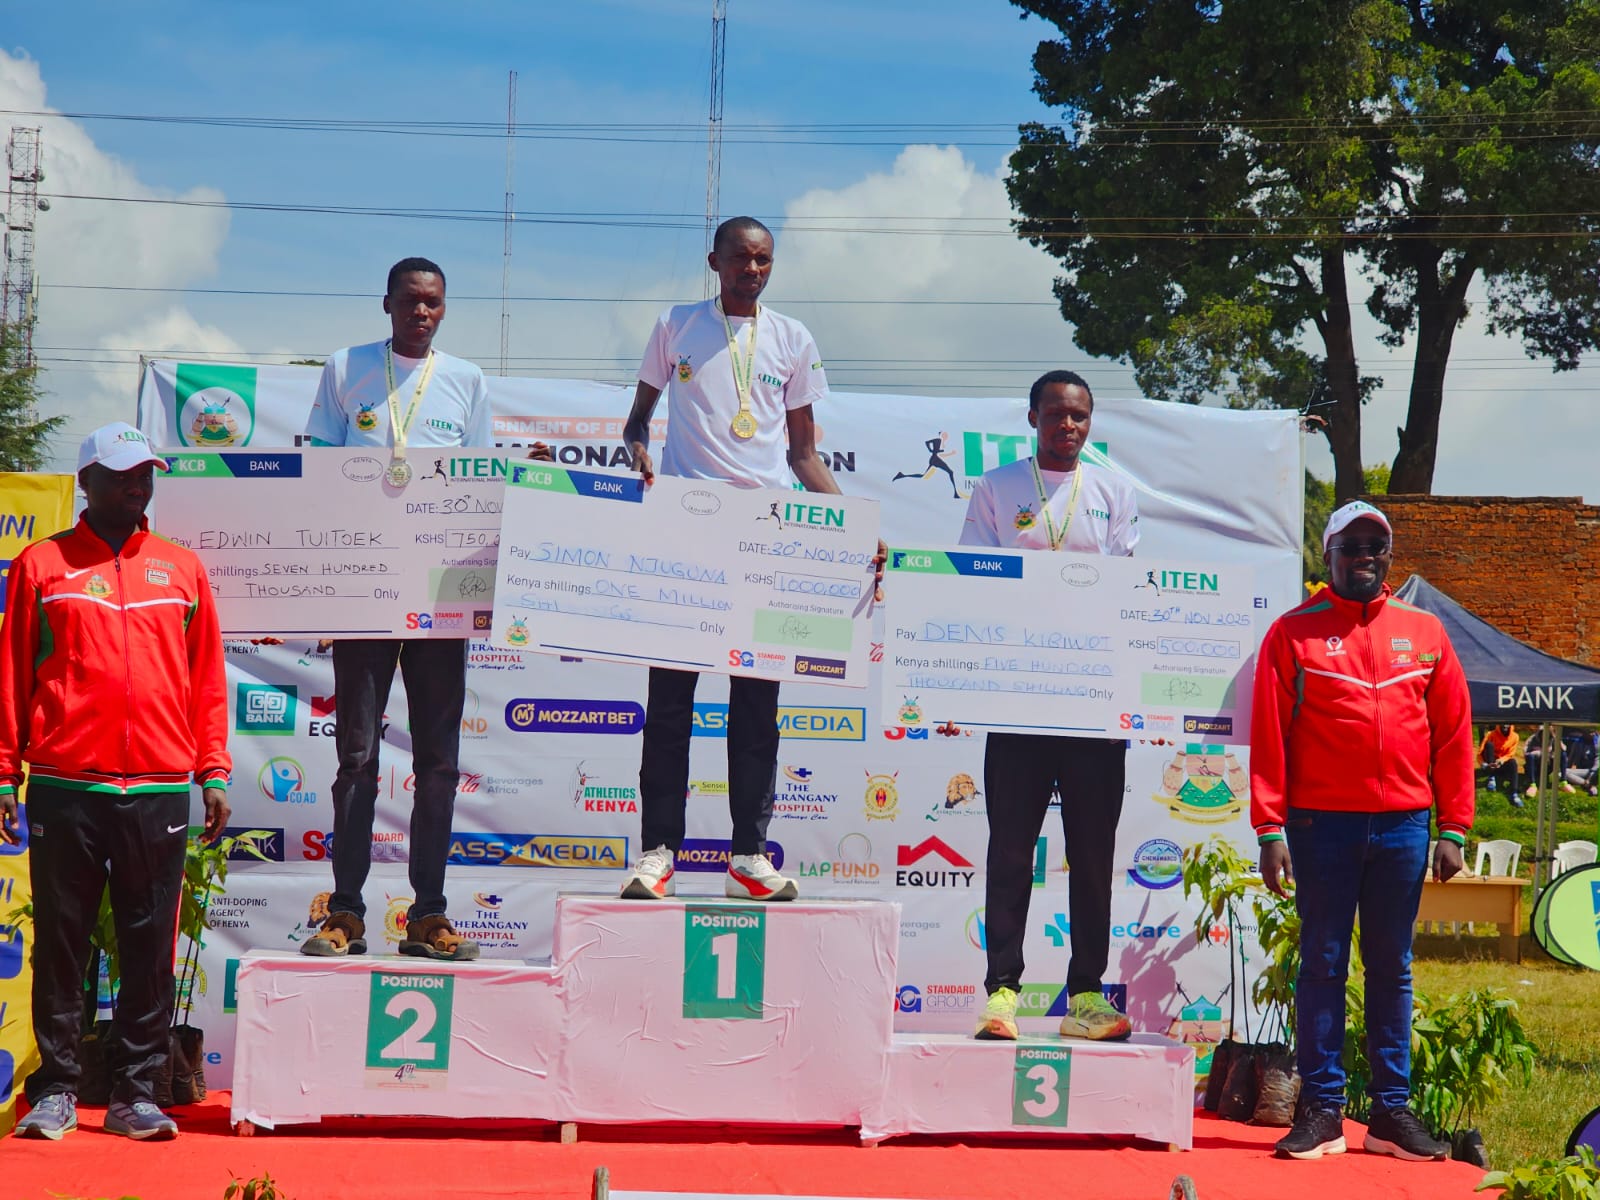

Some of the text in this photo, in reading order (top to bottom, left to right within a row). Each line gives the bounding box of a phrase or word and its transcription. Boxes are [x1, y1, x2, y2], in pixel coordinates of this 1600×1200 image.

[762, 373, 782, 388] ITEN
[431, 419, 453, 430] ITEN
[494, 420, 570, 435] RNMENT
[576, 422, 601, 434] OF
[178, 459, 280, 471] KCB BANK
[450, 457, 508, 477] ITEN
[526, 470, 624, 494] KCB BANK
[406, 503, 438, 514] DATE:
[784, 503, 845, 527] ITEN
[200, 531, 271, 549] EDWIN
[295, 529, 383, 547] TUITOEK
[415, 533, 445, 544] KSHS
[739, 541, 770, 555] DATE:
[441, 558, 484, 567] Authorising
[510, 542, 727, 584] Pay SIMON NJUGUNA
[906, 555, 1003, 571] KCB BANK
[209, 562, 388, 579] shillings SEVEN HUNDRED
[744, 572, 773, 585] KSHS
[1161, 570, 1218, 591] ITEN
[246, 582, 337, 596] THOUSAND
[374, 588, 400, 601] Only
[506, 574, 734, 612] Kenya shillings ONE MILLION
[768, 599, 844, 615] Authorising Signature
[406, 612, 432, 630] SG
[1152, 606, 1181, 622] 30TH
[1184, 612, 1211, 625] NOV
[1216, 612, 1251, 626] 2025
[700, 620, 725, 636] Only
[896, 628, 917, 641] Pay
[925, 621, 1007, 642] DENIS
[232, 646, 259, 654] KENYA
[1128, 638, 1156, 650] KSHS
[728, 648, 755, 668] SG
[895, 655, 1113, 674] Kenya shillings FIVE HUNDRED
[809, 664, 845, 675] MOZZART
[1153, 663, 1227, 675] Authorising Signature
[906, 673, 1001, 690] THOUSAND
[1089, 688, 1114, 700] Only
[1497, 685, 1574, 710] BANK
[246, 714, 285, 724] BANK
[1120, 712, 1145, 730] SG
[1198, 721, 1232, 731] MOZZART
[487, 776, 544, 787] Beverages
[786, 782, 809, 792] THE
[487, 786, 519, 795] Africa
[584, 787, 636, 799] ATHLETICS
[289, 792, 317, 804] COAD
[774, 793, 838, 803] ERANGANY
[585, 799, 638, 813] KENYA
[372, 832, 404, 842] NDARD
[450, 842, 617, 861] ASS MEDIA
[799, 861, 880, 878] LAPFUND
[895, 870, 975, 888] EQUITY
[210, 908, 245, 917] AGENCY
[476, 910, 501, 920] THE
[222, 920, 250, 928] KENYA
[691, 914, 760, 928] POSITION
[900, 921, 941, 929] verages
[1111, 922, 1181, 939] eCare
[711, 932, 738, 999] 1
[381, 975, 444, 989] POSITION
[927, 985, 975, 995] STANDARD
[926, 994, 975, 1009] GROUP
[1017, 992, 1051, 1009] KCB
[380, 990, 438, 1061] 2
[1020, 1049, 1067, 1061] POSITION
[1022, 1063, 1060, 1118] 3
